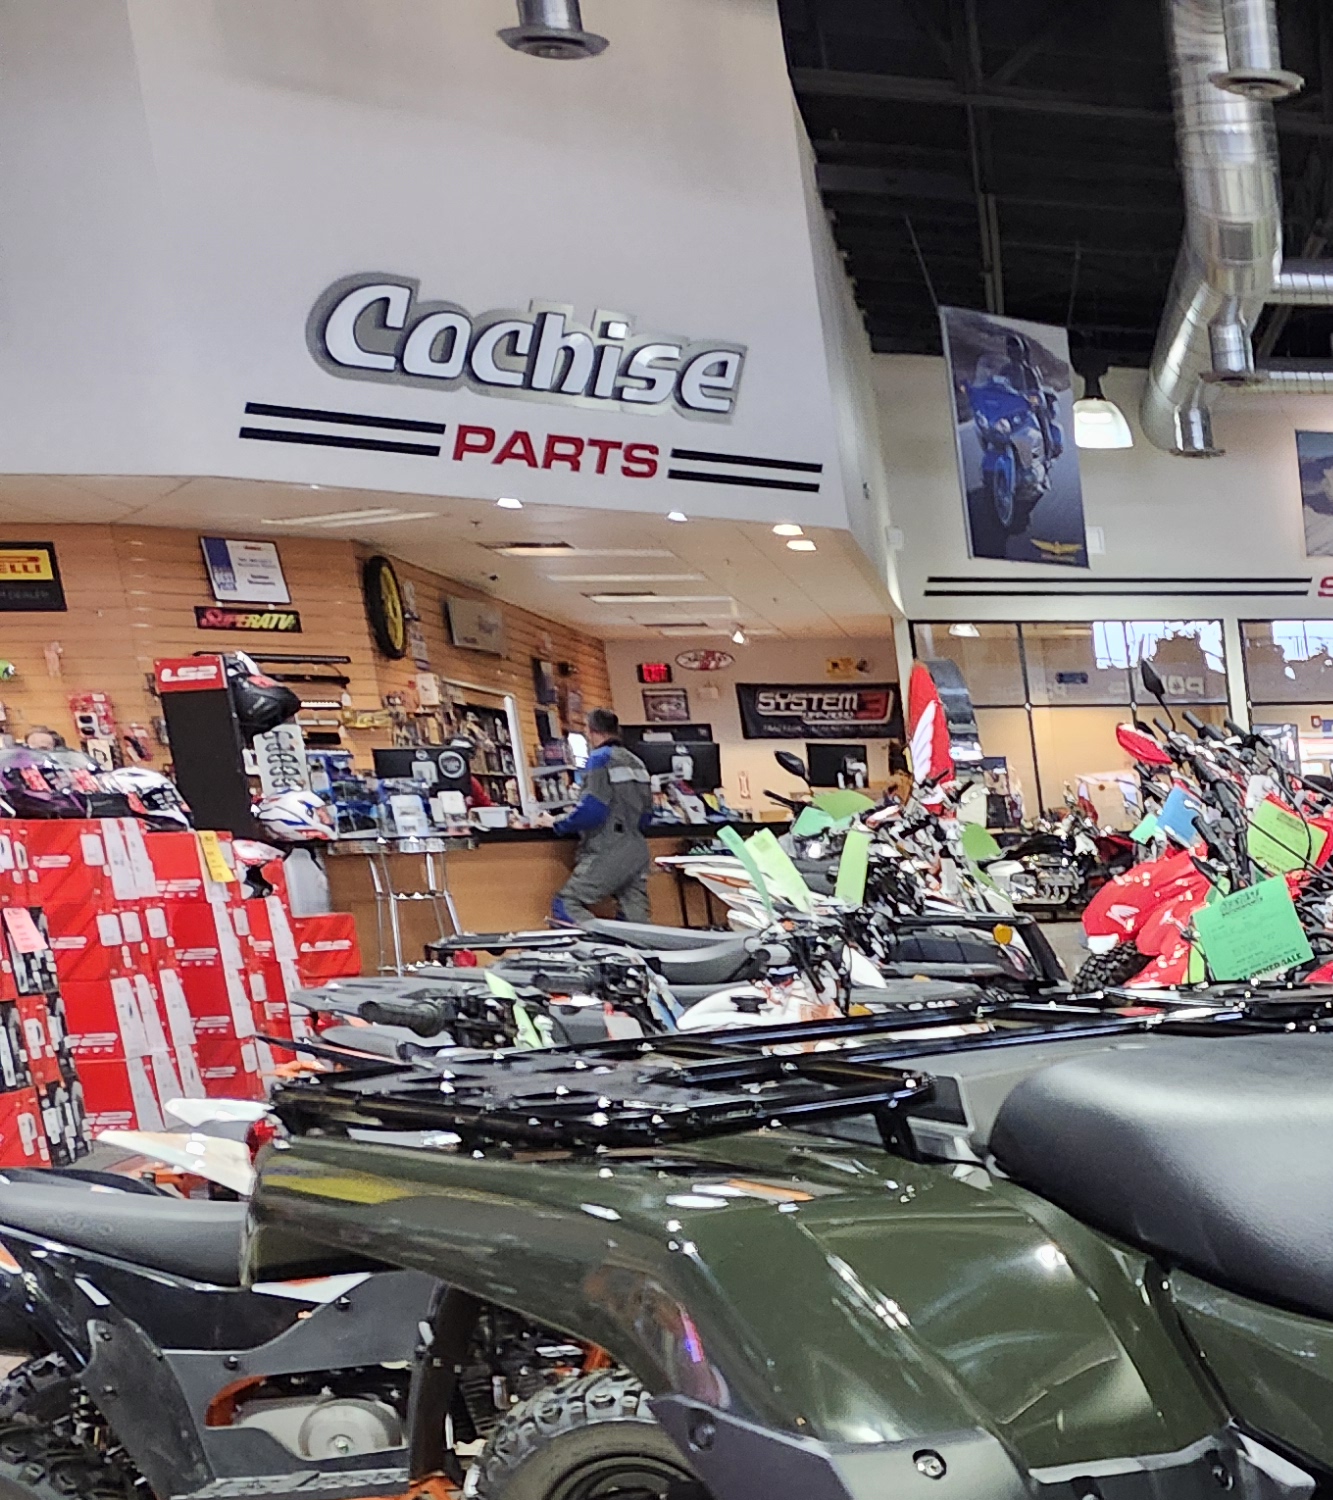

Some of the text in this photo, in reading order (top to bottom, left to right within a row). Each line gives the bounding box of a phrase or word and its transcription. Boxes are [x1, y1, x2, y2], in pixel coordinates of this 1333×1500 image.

[318, 280, 747, 416] Cochise
[451, 423, 661, 479] PARTS
[757, 689, 858, 712] SYSTEM
